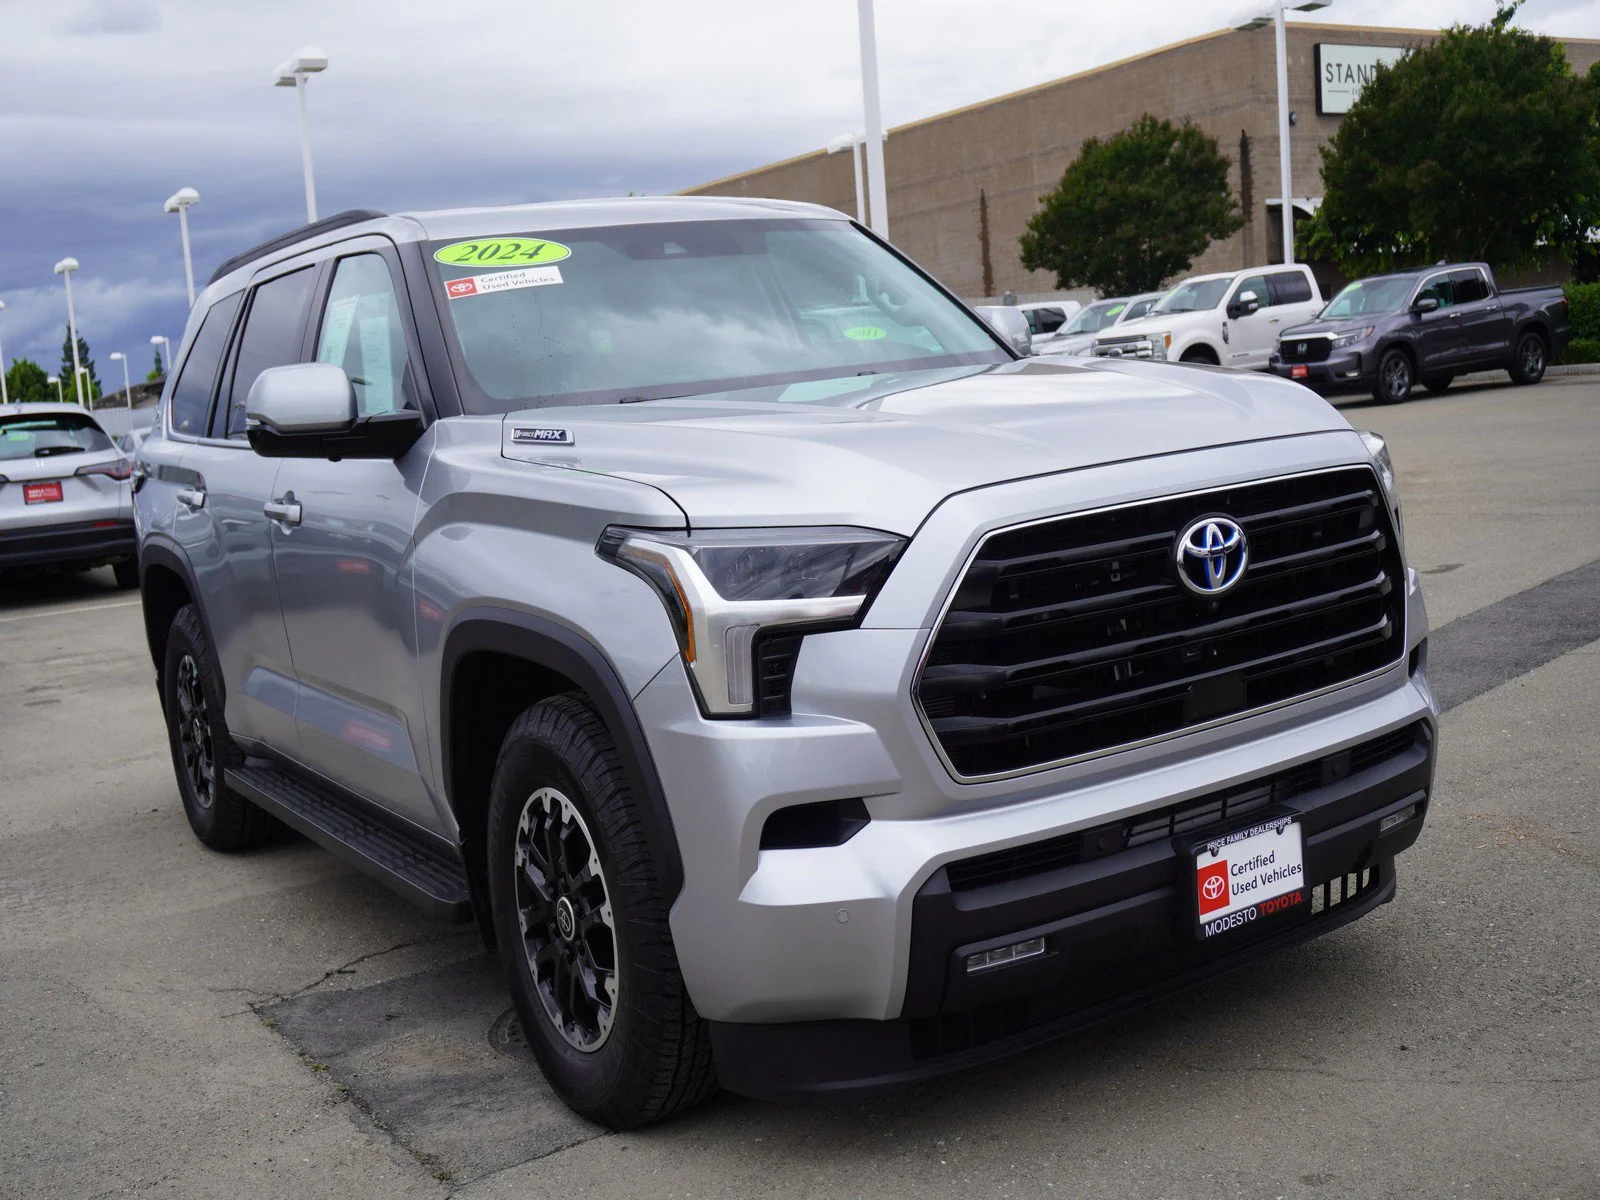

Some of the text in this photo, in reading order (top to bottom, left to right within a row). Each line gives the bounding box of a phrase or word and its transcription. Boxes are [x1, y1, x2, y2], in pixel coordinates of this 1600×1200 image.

[452, 243, 546, 262] 2024
[480, 272, 526, 283] Certified
[482, 276, 555, 290] Used Vehicles
[534, 429, 562, 440] MAX
[1207, 816, 1292, 851] PRICE FAMILY DEALERSHIPS
[1230, 850, 1275, 876] Certified
[1231, 863, 1302, 896] Used Vehicles
[1205, 891, 1303, 938] MODESTO TOYOTA
